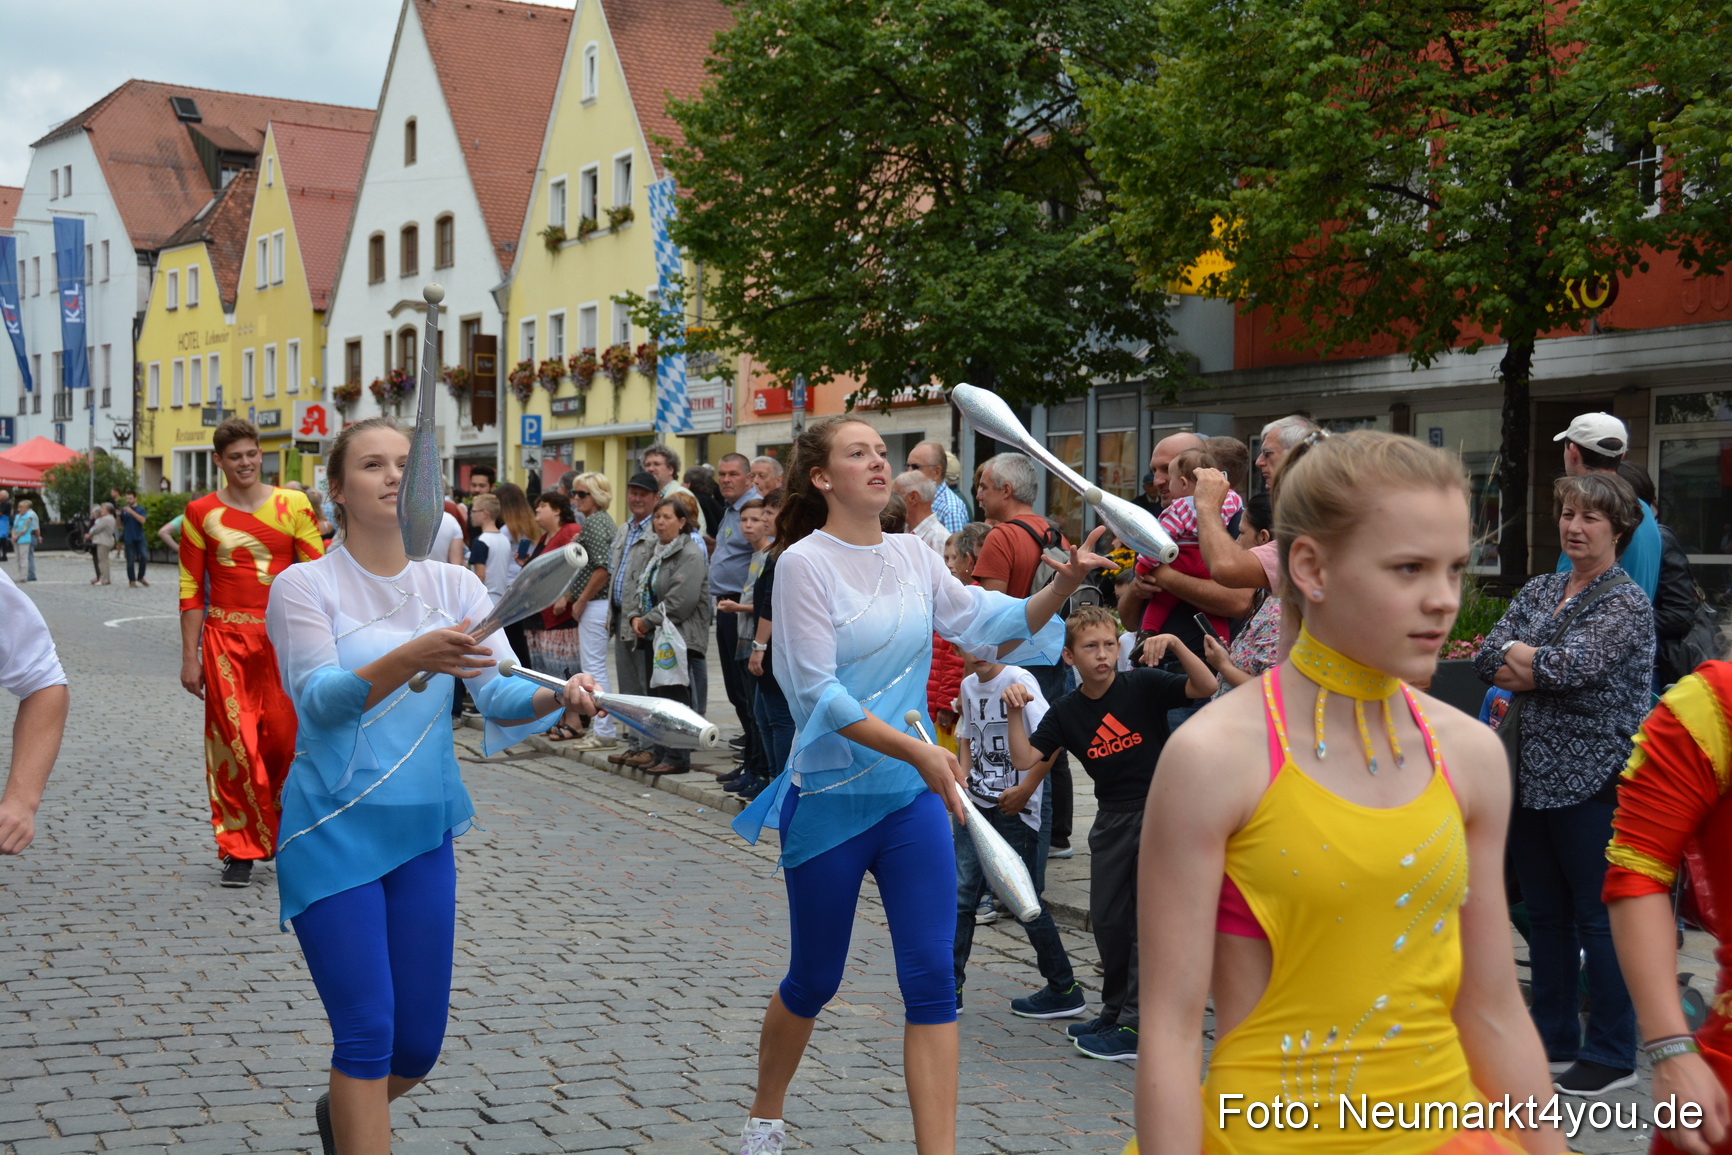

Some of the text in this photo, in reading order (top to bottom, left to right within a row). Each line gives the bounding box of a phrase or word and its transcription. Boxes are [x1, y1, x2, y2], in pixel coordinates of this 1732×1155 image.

[178, 331, 200, 350] HOTEL
[525, 418, 538, 442] P
[1087, 732, 1143, 759] adidas
